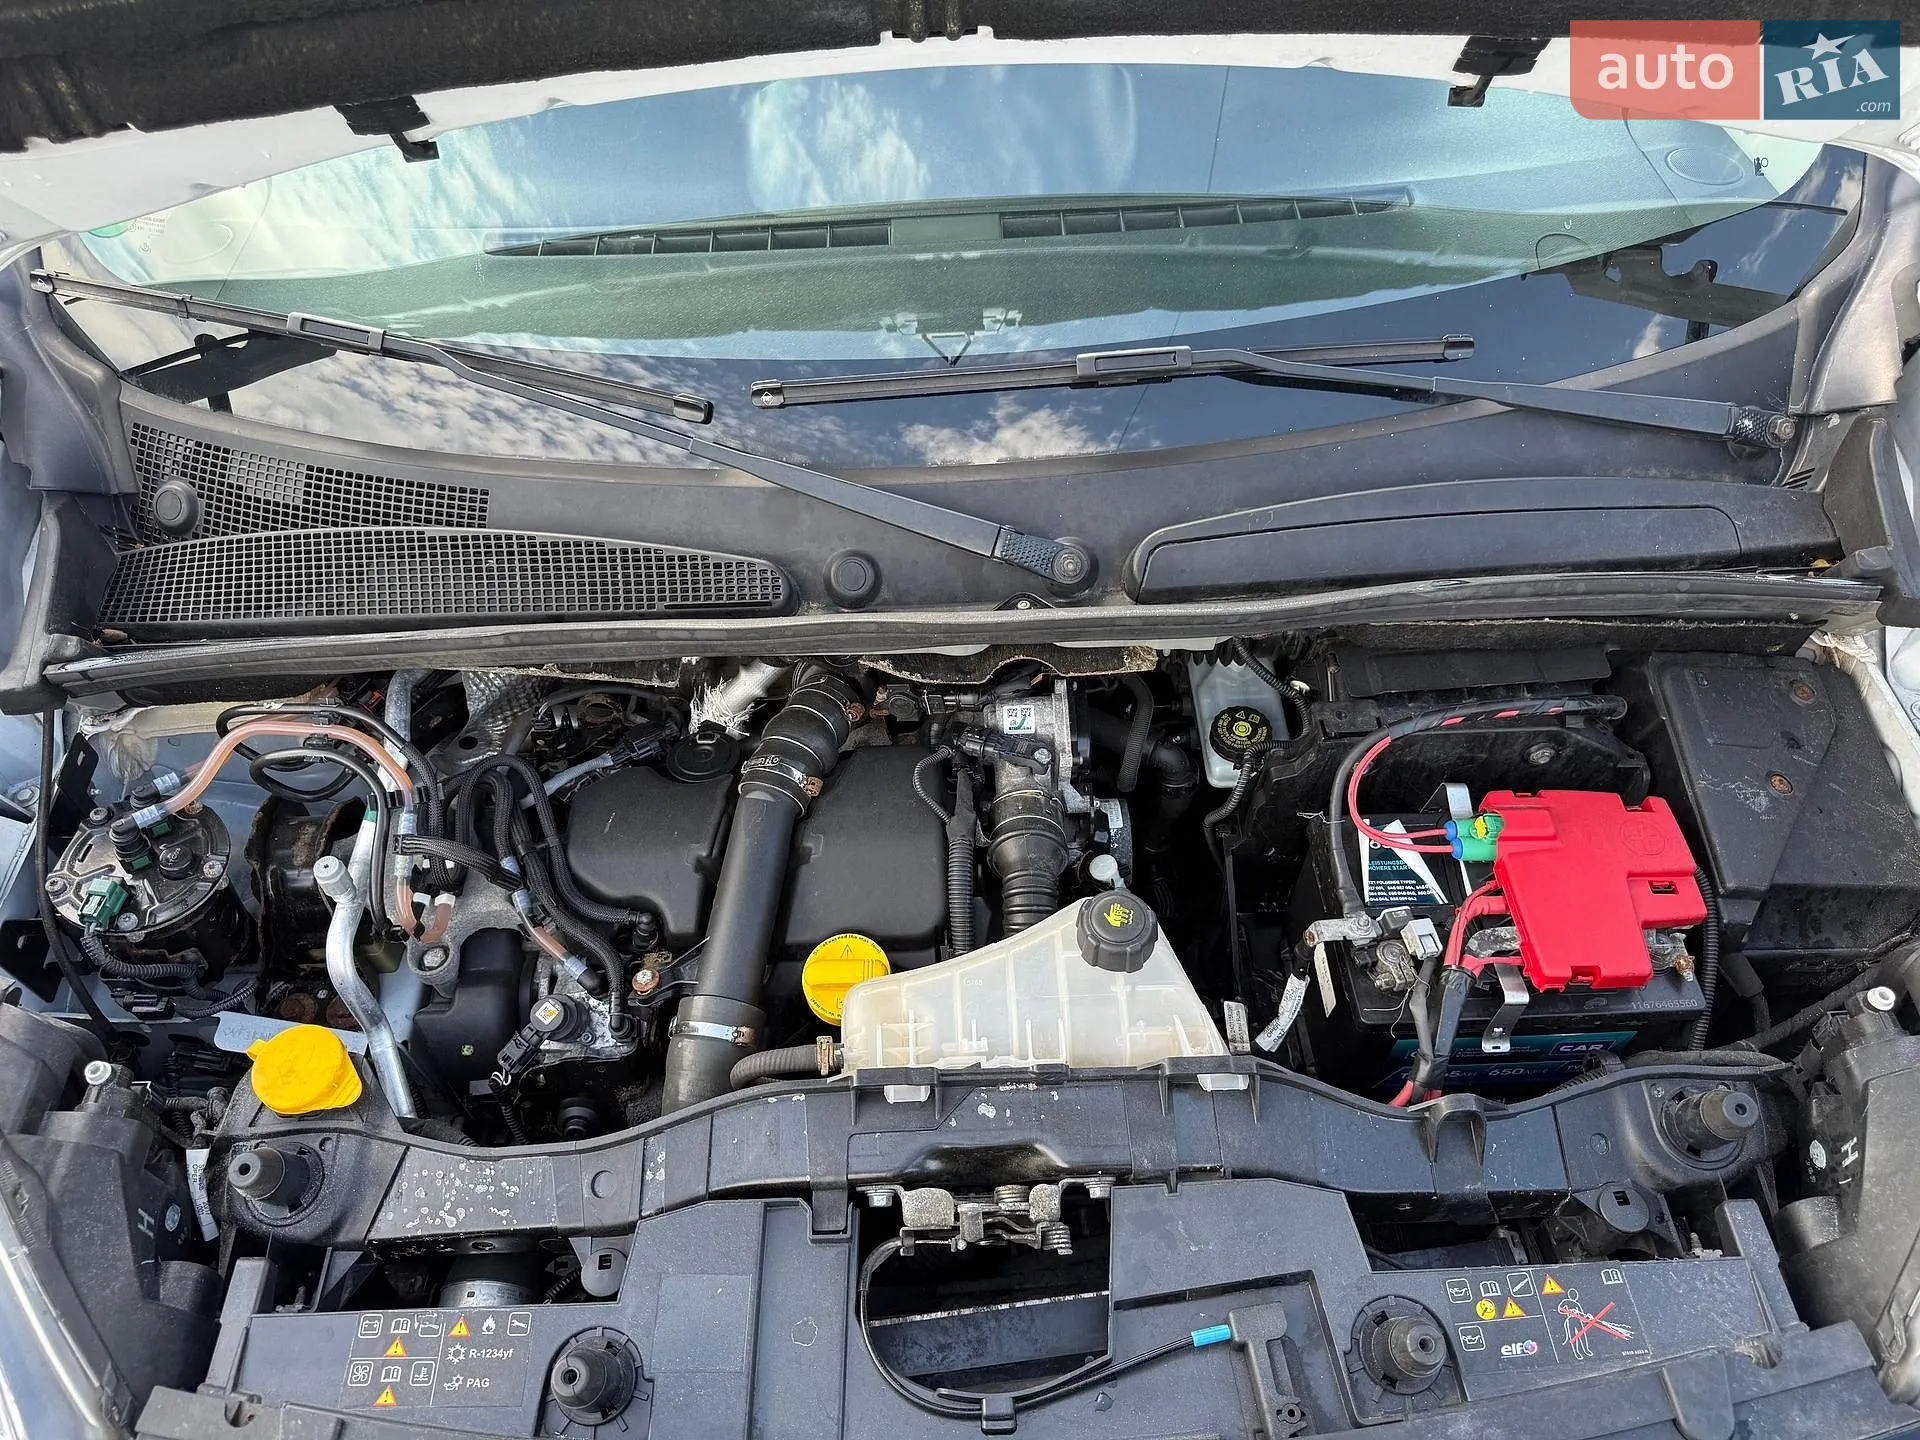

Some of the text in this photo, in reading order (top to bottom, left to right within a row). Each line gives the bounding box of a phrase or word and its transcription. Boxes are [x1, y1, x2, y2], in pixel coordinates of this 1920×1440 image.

[1560, 1044, 1604, 1052] CAR
[468, 1347, 514, 1361] R-1234yf
[1500, 1342, 1524, 1356] elf
[466, 1377, 490, 1388] PAG
